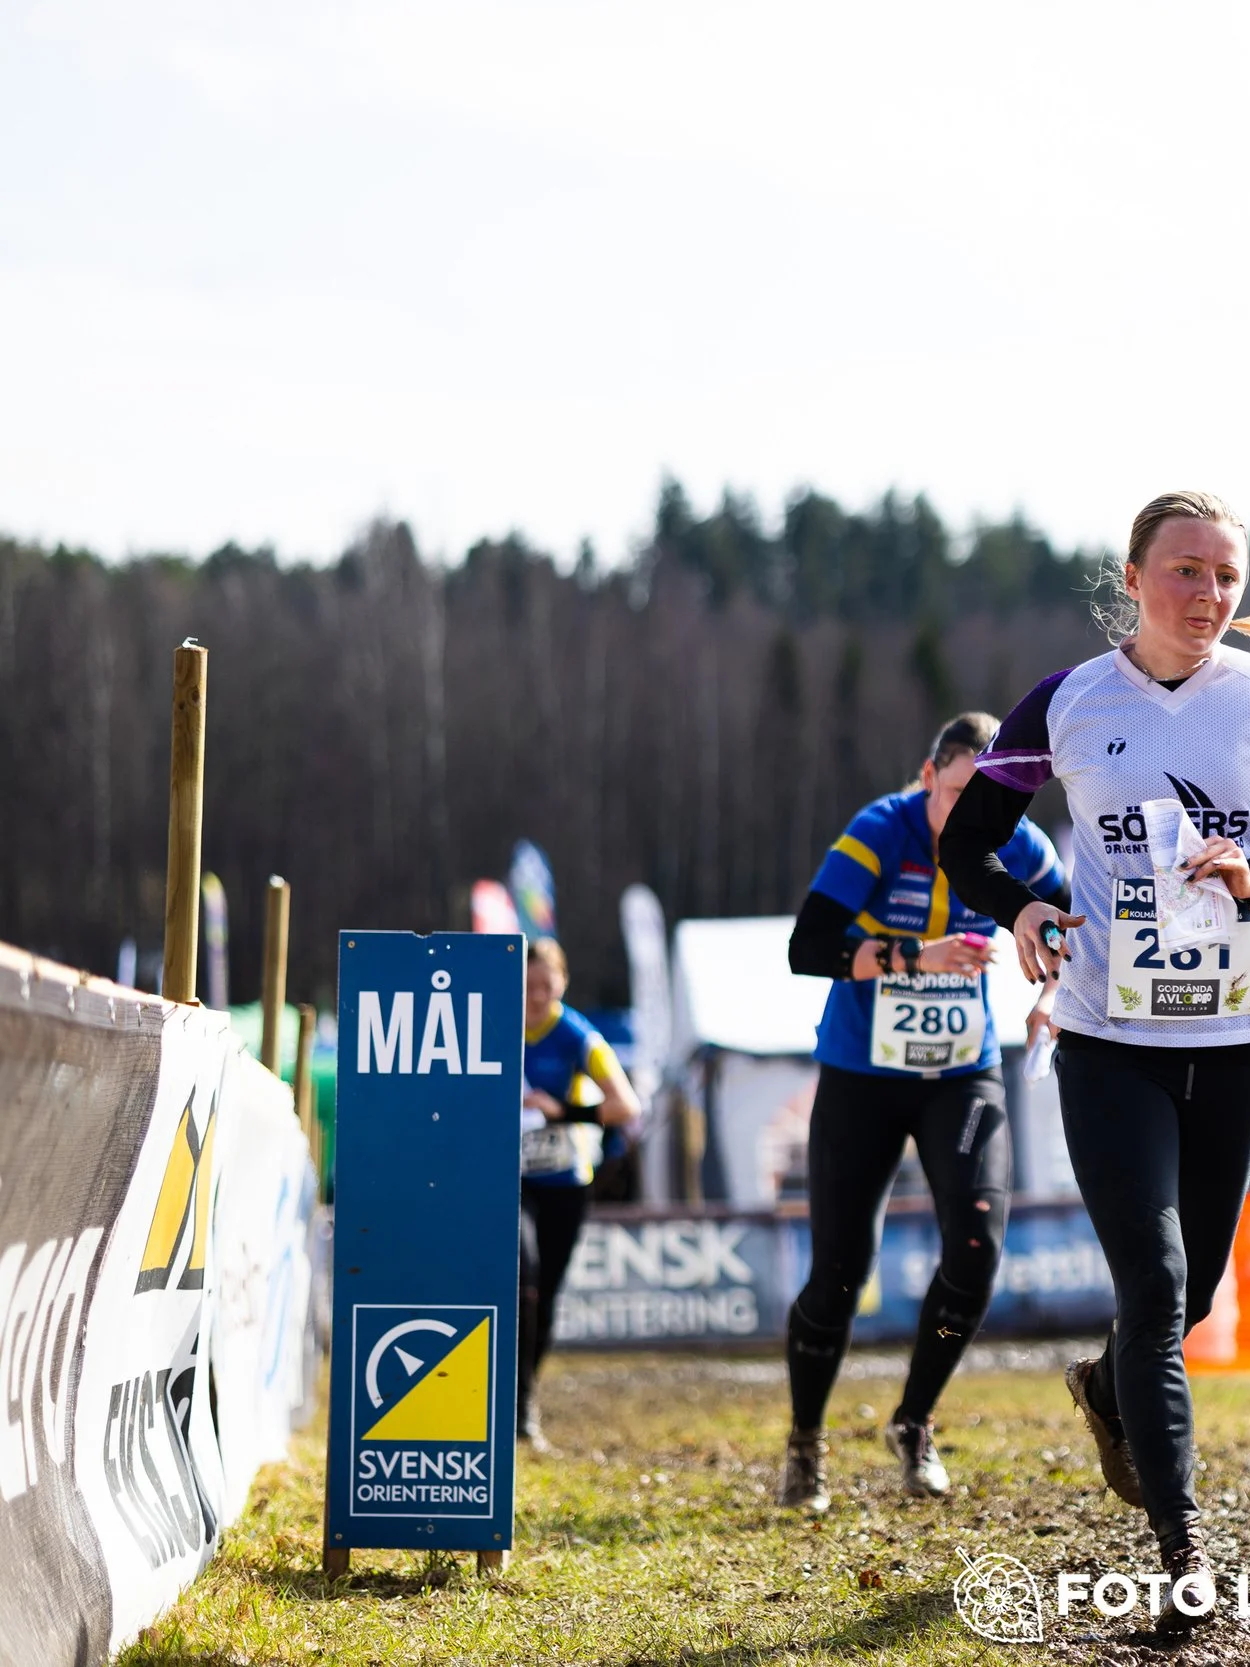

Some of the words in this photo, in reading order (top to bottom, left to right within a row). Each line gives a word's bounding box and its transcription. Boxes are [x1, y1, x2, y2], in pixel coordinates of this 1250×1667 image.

[1156, 992, 1213, 1005] AVLOPP
[357, 969, 503, 1075] MÅL
[893, 1003, 968, 1036] 280
[570, 1219, 754, 1289] ENSK
[554, 1286, 759, 1341] ENTERING
[358, 1450, 487, 1481] SVENSK
[357, 1484, 488, 1504] ORIENTERING
